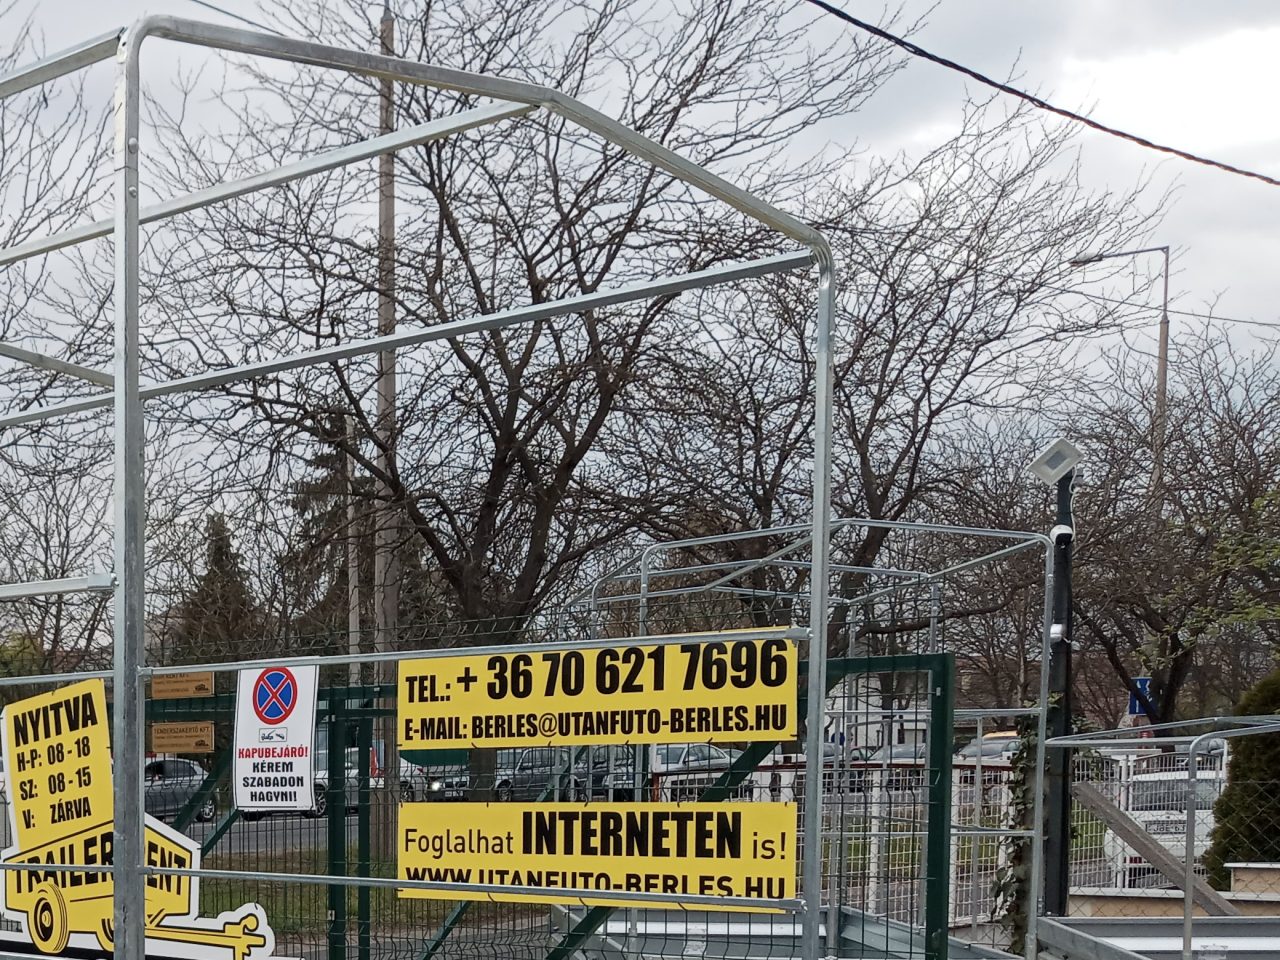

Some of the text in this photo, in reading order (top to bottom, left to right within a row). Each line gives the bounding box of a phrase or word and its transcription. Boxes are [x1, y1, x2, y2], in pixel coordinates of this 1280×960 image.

[405, 674, 451, 703] TEL.:
[487, 654, 533, 700] 36
[542, 651, 585, 697] 70
[595, 645, 666, 695] 621
[681, 639, 787, 690] 7696
[13, 692, 98, 748] NYITVA
[404, 704, 787, 741] E-MAIL: BERLES@UTANFUTO-BERLES.HU
[17, 748, 43, 773] H-P:
[47, 742, 65, 765] 08
[74, 736, 91, 758] 18
[238, 744, 308, 759] KAPUBEJÁRÓ!
[252, 760, 293, 773] KÉREM
[19, 779, 38, 801] SZ:
[48, 772, 66, 795] 08
[75, 766, 92, 788] 15
[242, 776, 304, 788] SZABADON
[250, 791, 297, 802] HAGYNI!
[22, 797, 92, 829] V: ZÁRVA
[404, 811, 787, 859] Foglalhat INTERNETEN is!
[147, 840, 187, 896] ENT
[405, 867, 786, 899] WWWUTANFUTO-BERLES.HU
